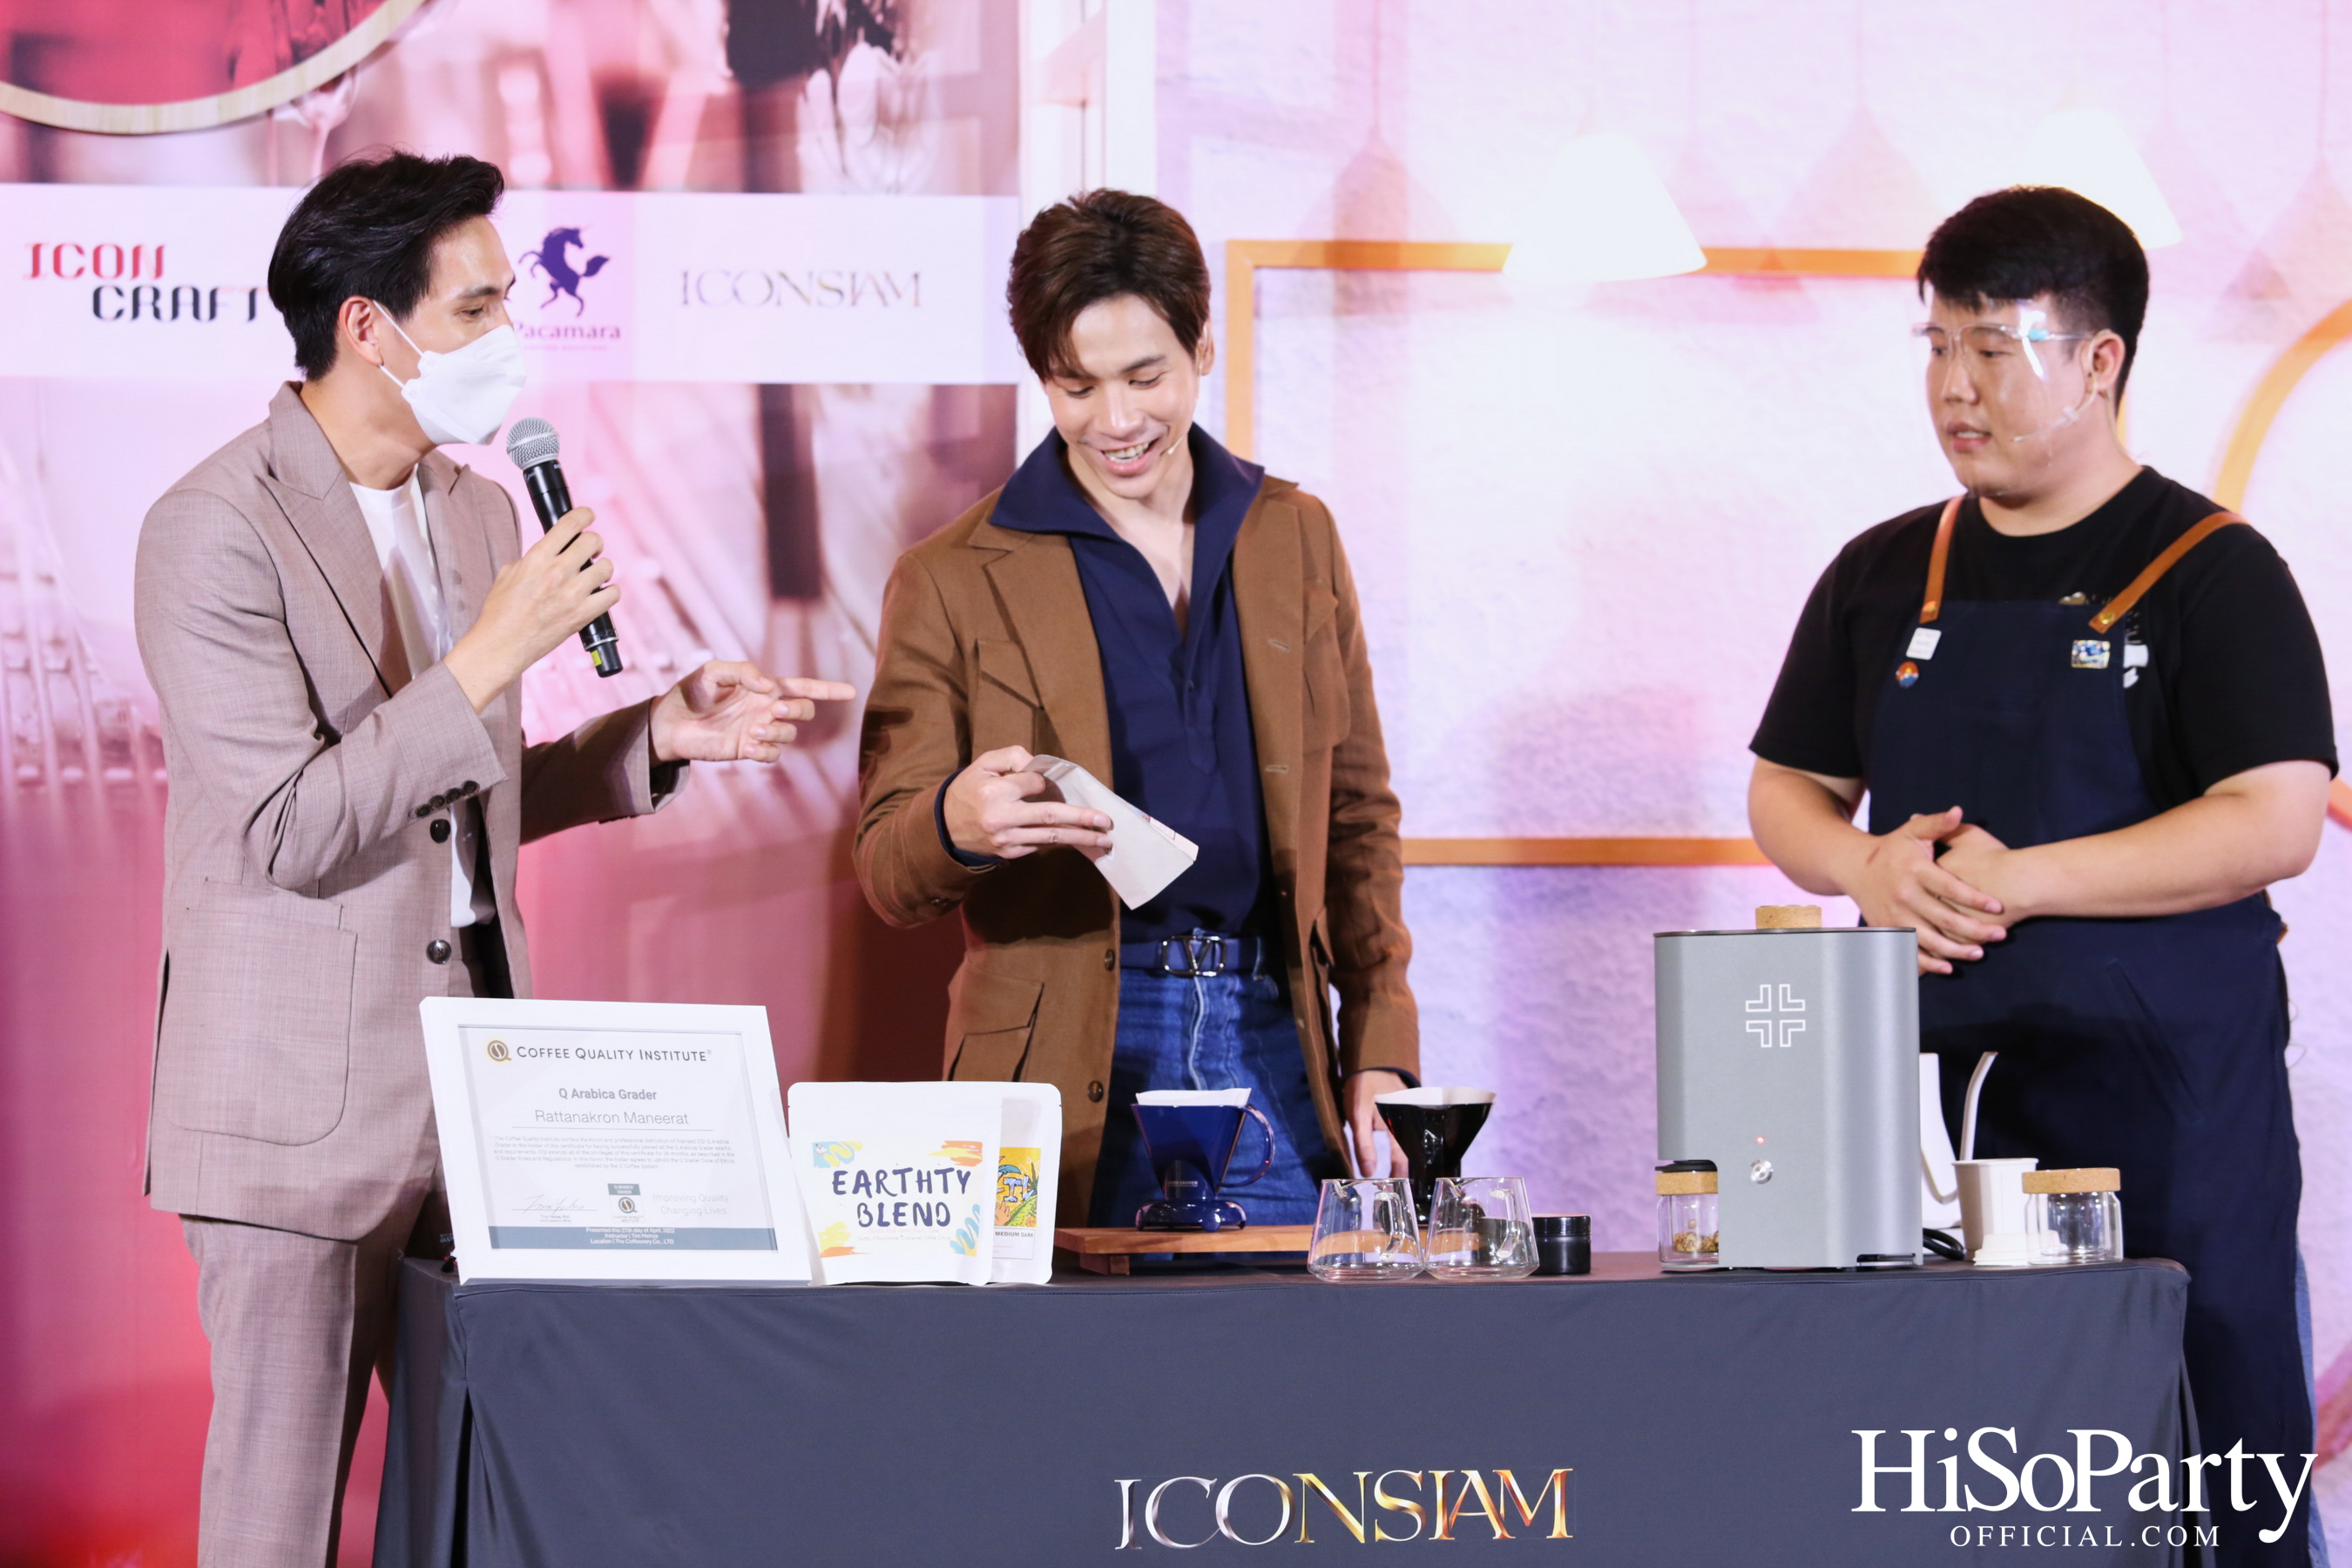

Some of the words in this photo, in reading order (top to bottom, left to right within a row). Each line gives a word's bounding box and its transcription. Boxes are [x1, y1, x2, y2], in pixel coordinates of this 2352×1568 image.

[22, 242, 167, 280] ICON
[679, 269, 921, 308] ICONSIAM
[91, 285, 267, 323] CRAFT
[517, 1046, 571, 1059] COFFEE
[575, 1047, 634, 1061] QUALITY
[558, 1087, 569, 1100] Q
[571, 1088, 616, 1100] Arabica
[618, 1089, 658, 1101] Grader
[535, 1110, 620, 1124] Rattanakron
[624, 1112, 689, 1125] Maneerat
[832, 1167, 971, 1199] EARTHTY
[652, 1193, 697, 1204] Improving
[660, 1206, 702, 1216] Changing
[856, 1201, 951, 1227] BLEND
[1114, 1468, 1574, 1551] ICONSIAM
